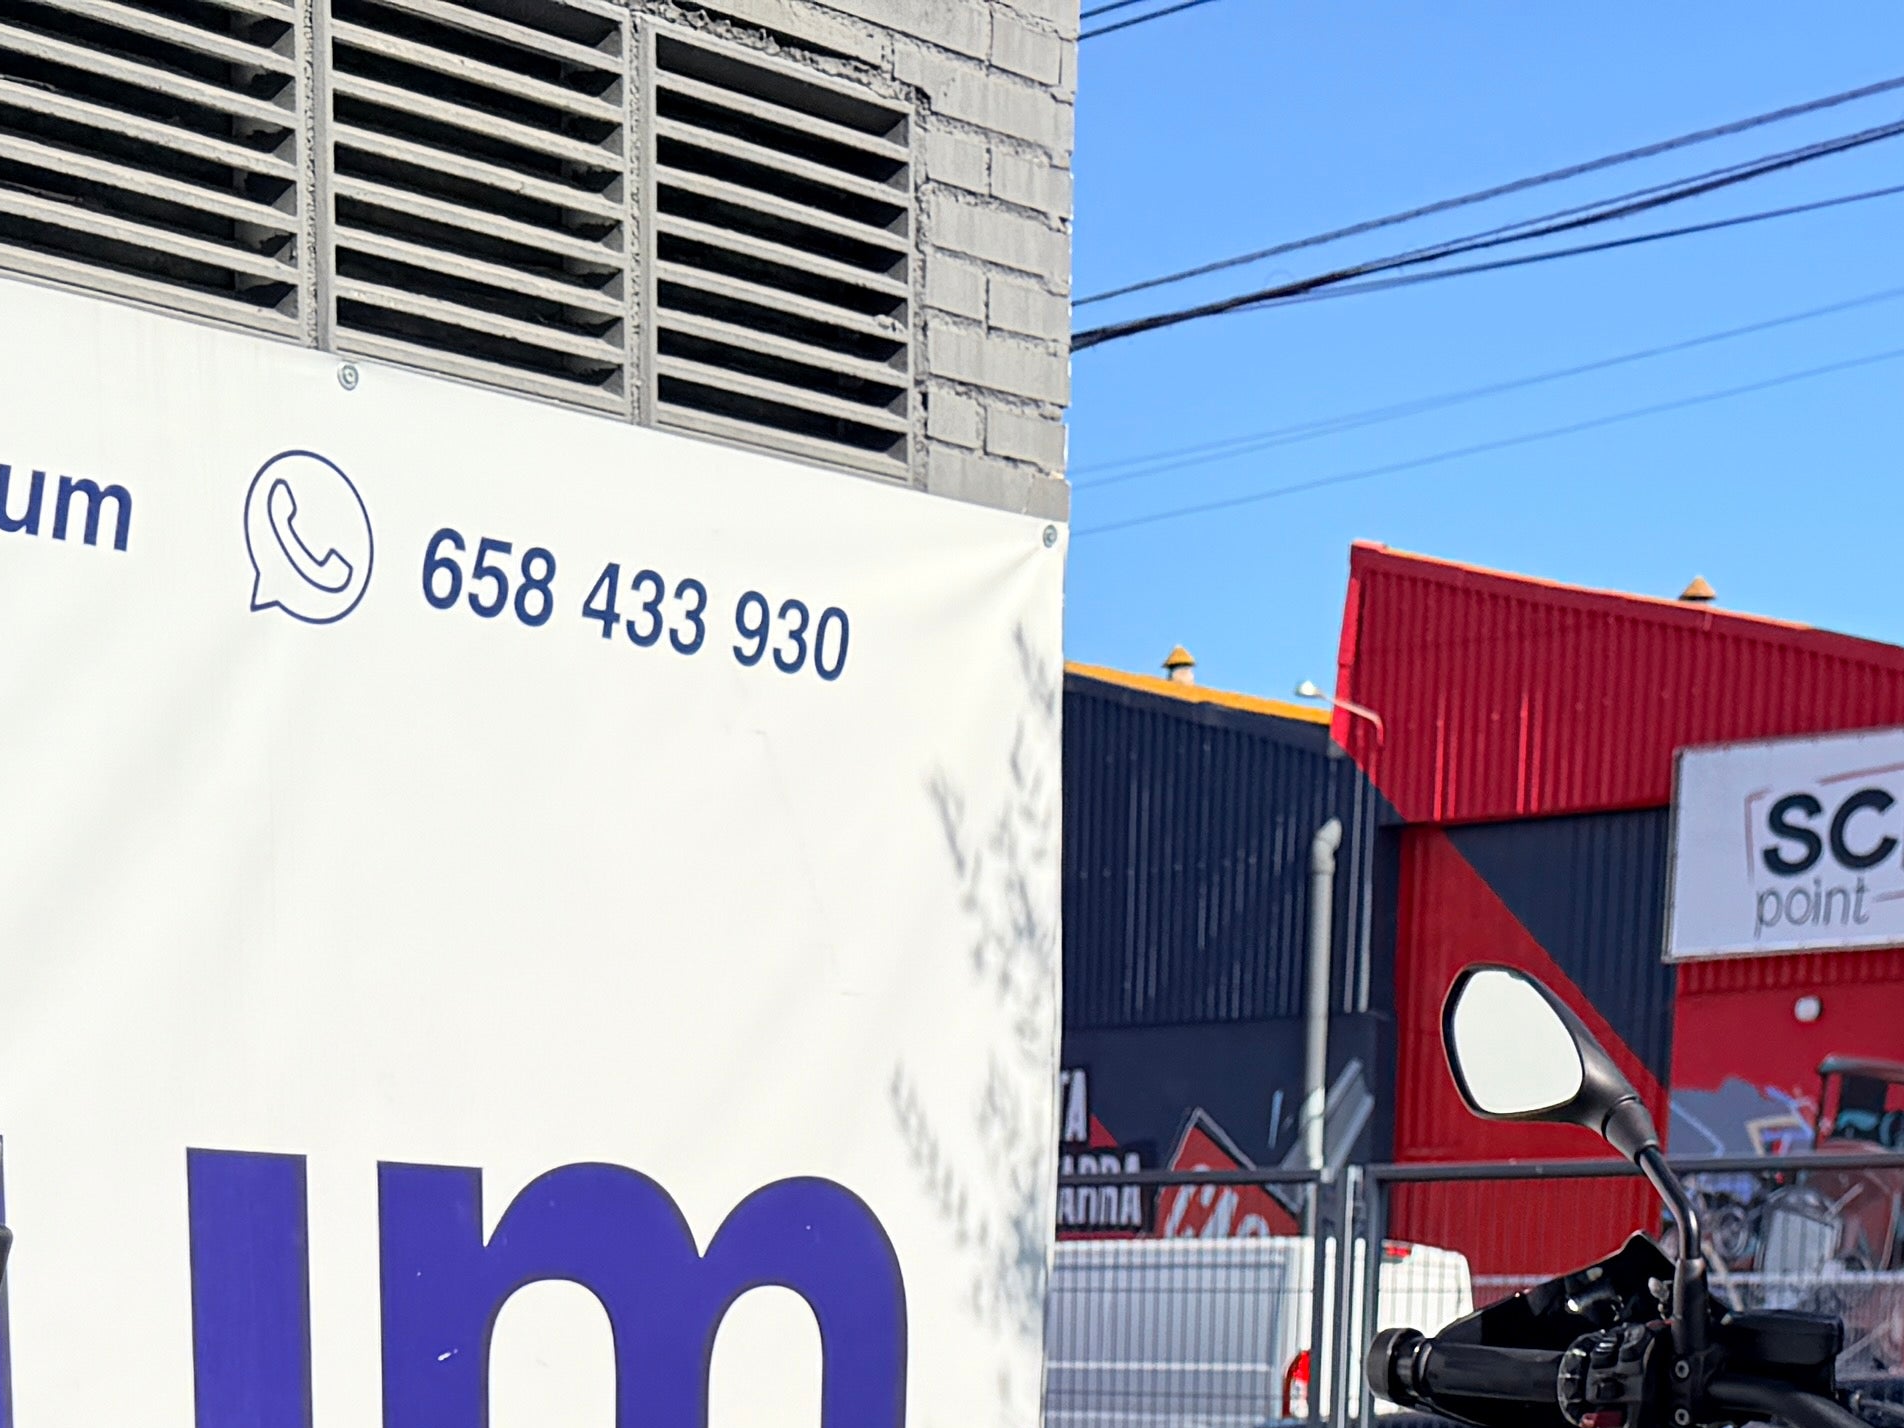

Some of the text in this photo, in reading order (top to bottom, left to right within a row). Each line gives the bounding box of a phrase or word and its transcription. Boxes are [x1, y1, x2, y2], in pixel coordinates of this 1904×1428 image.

[422, 528, 849, 681] 658 433 930
[1753, 875, 1870, 939] point
